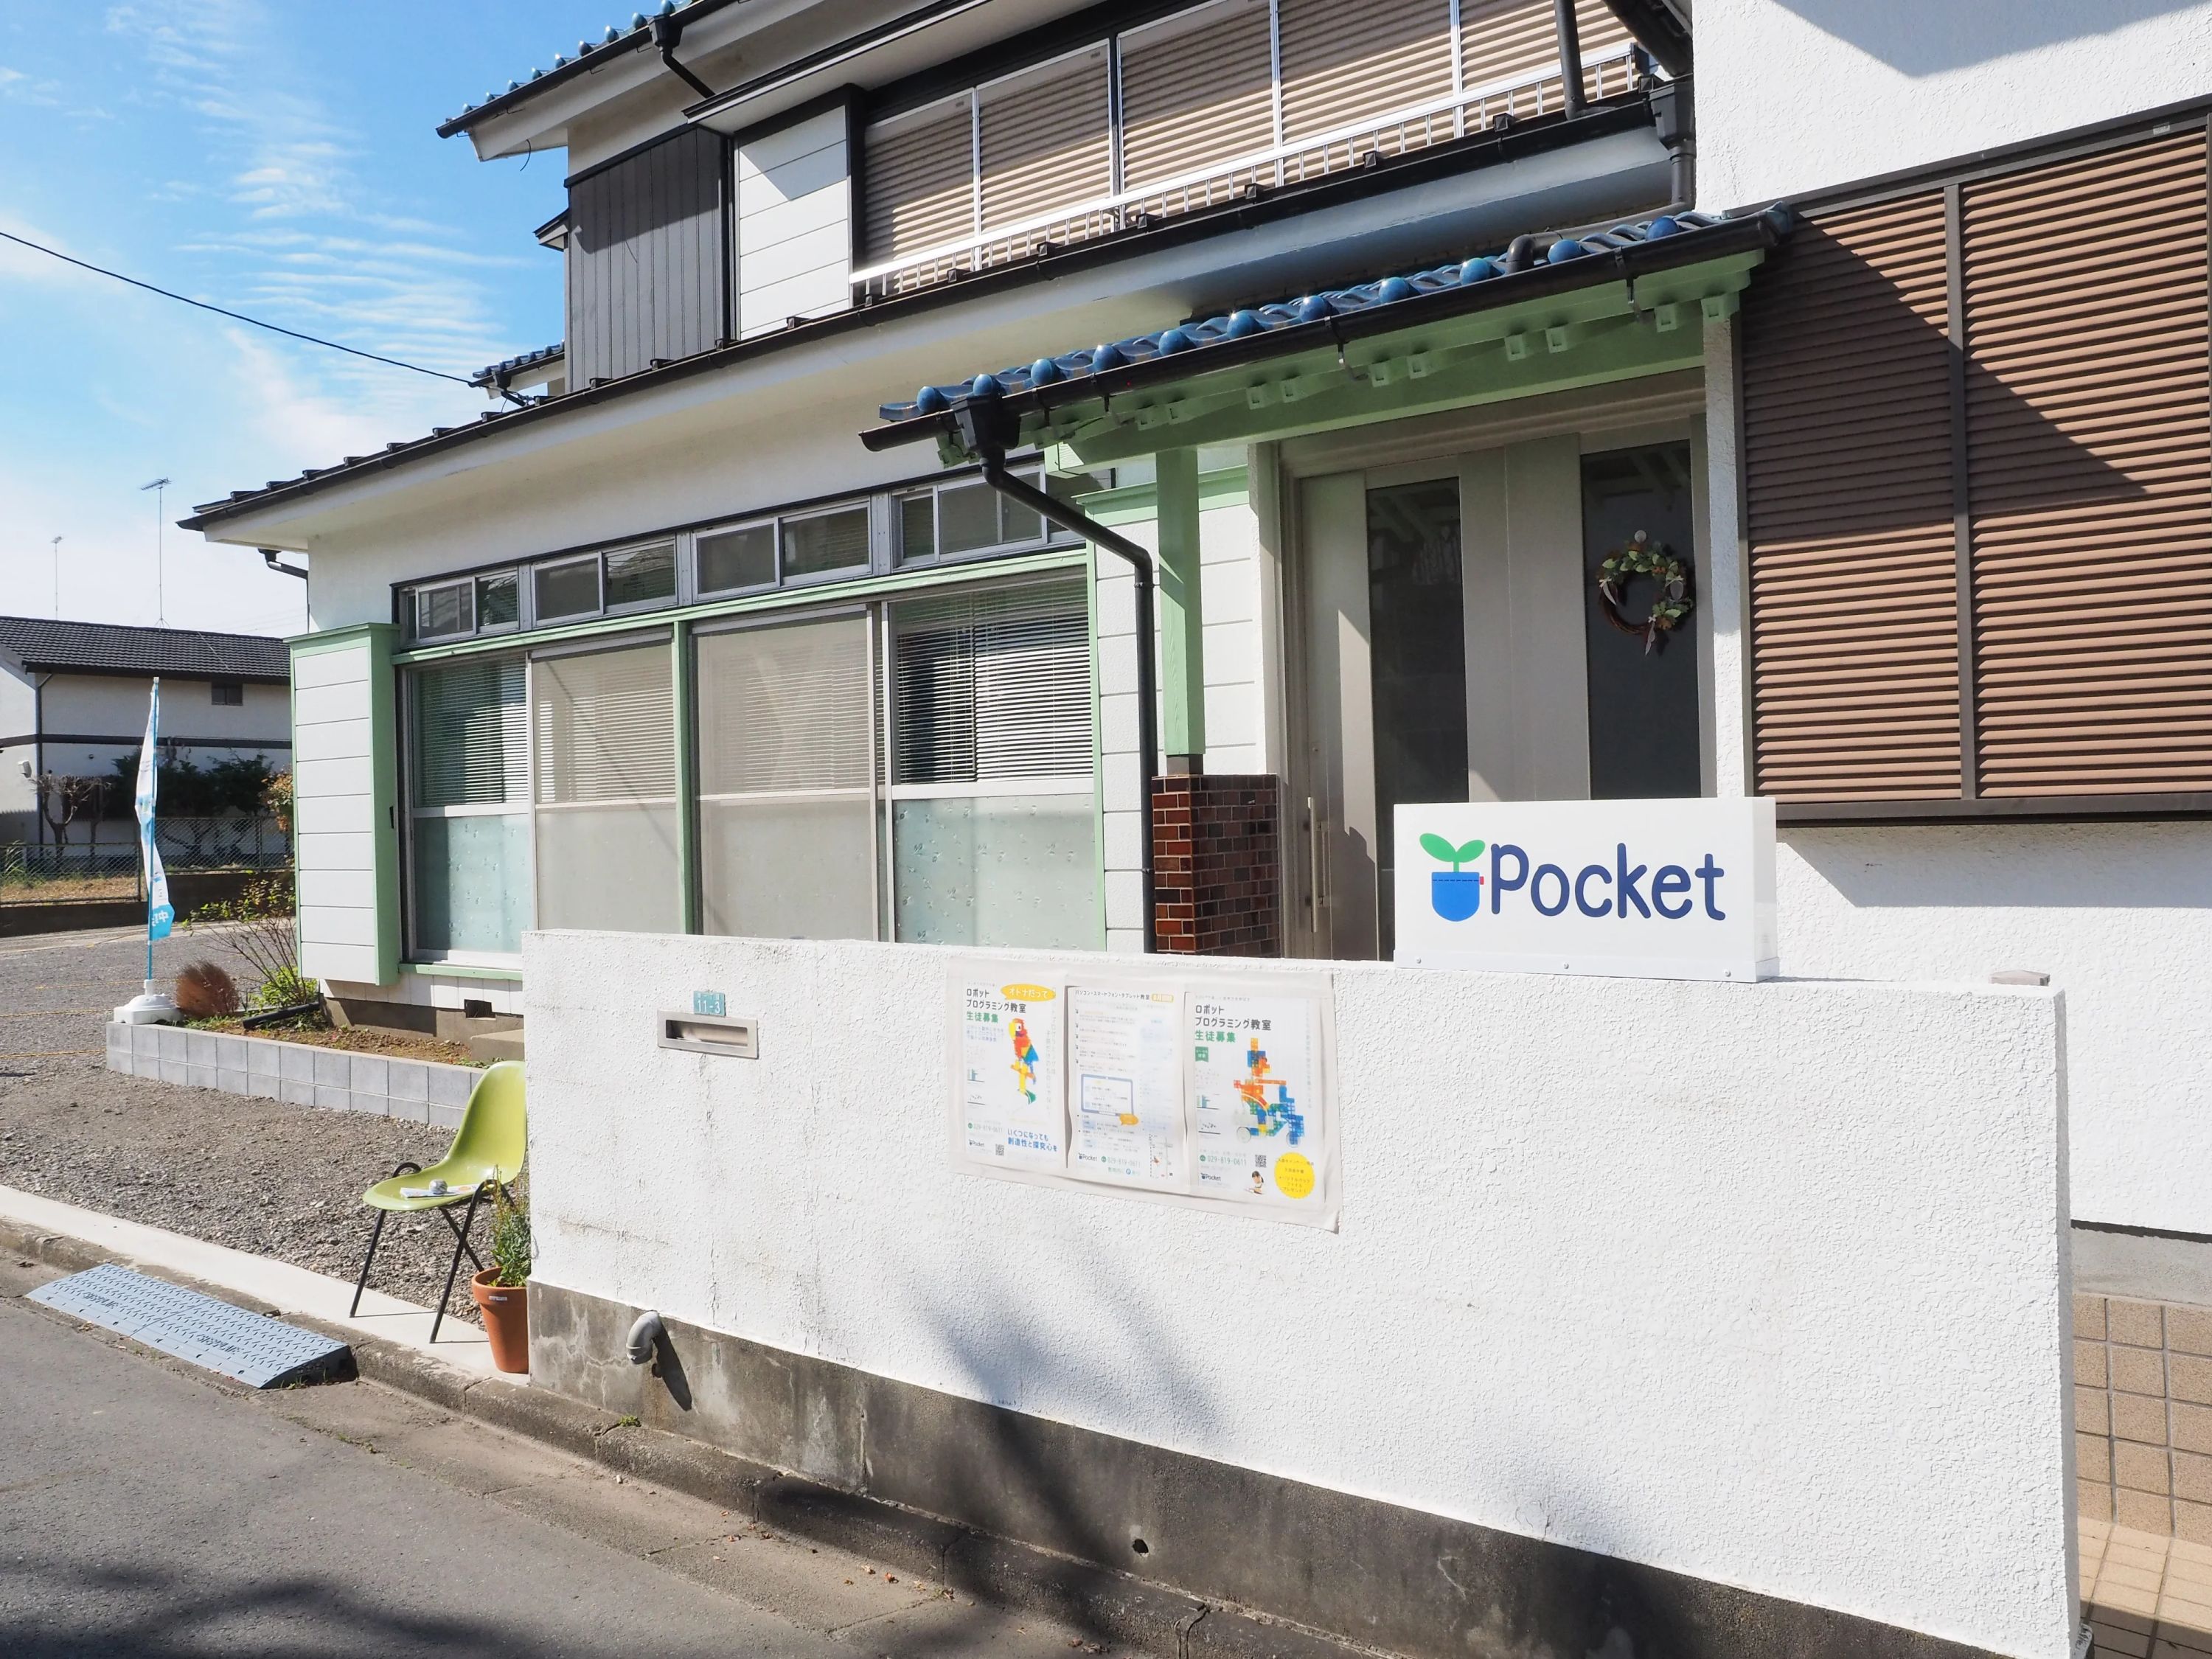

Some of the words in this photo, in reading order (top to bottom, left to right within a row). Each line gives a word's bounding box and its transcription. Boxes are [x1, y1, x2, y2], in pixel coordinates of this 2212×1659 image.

[1490, 843, 1726, 921] Pocket
[967, 988, 990, 998] ロボット
[1009, 987, 1048, 998] オトナだって
[697, 999, 720, 1014] 11-3
[967, 999, 1026, 1013] プログラミング教室
[1195, 1004, 1225, 1015] ロボット
[967, 1012, 998, 1023] 生徒募集
[1195, 1017, 1271, 1031] プログラミング教室
[1194, 1030, 1236, 1043] 生徒募集
[1007, 1129, 1048, 1141] いくつになっても
[1007, 1137, 1058, 1152] 創造性と探究心を
[1082, 1153, 1098, 1161] Pocket
[1207, 1155, 1247, 1166] 029-819-0611
[1205, 1173, 1222, 1181] Pocket
